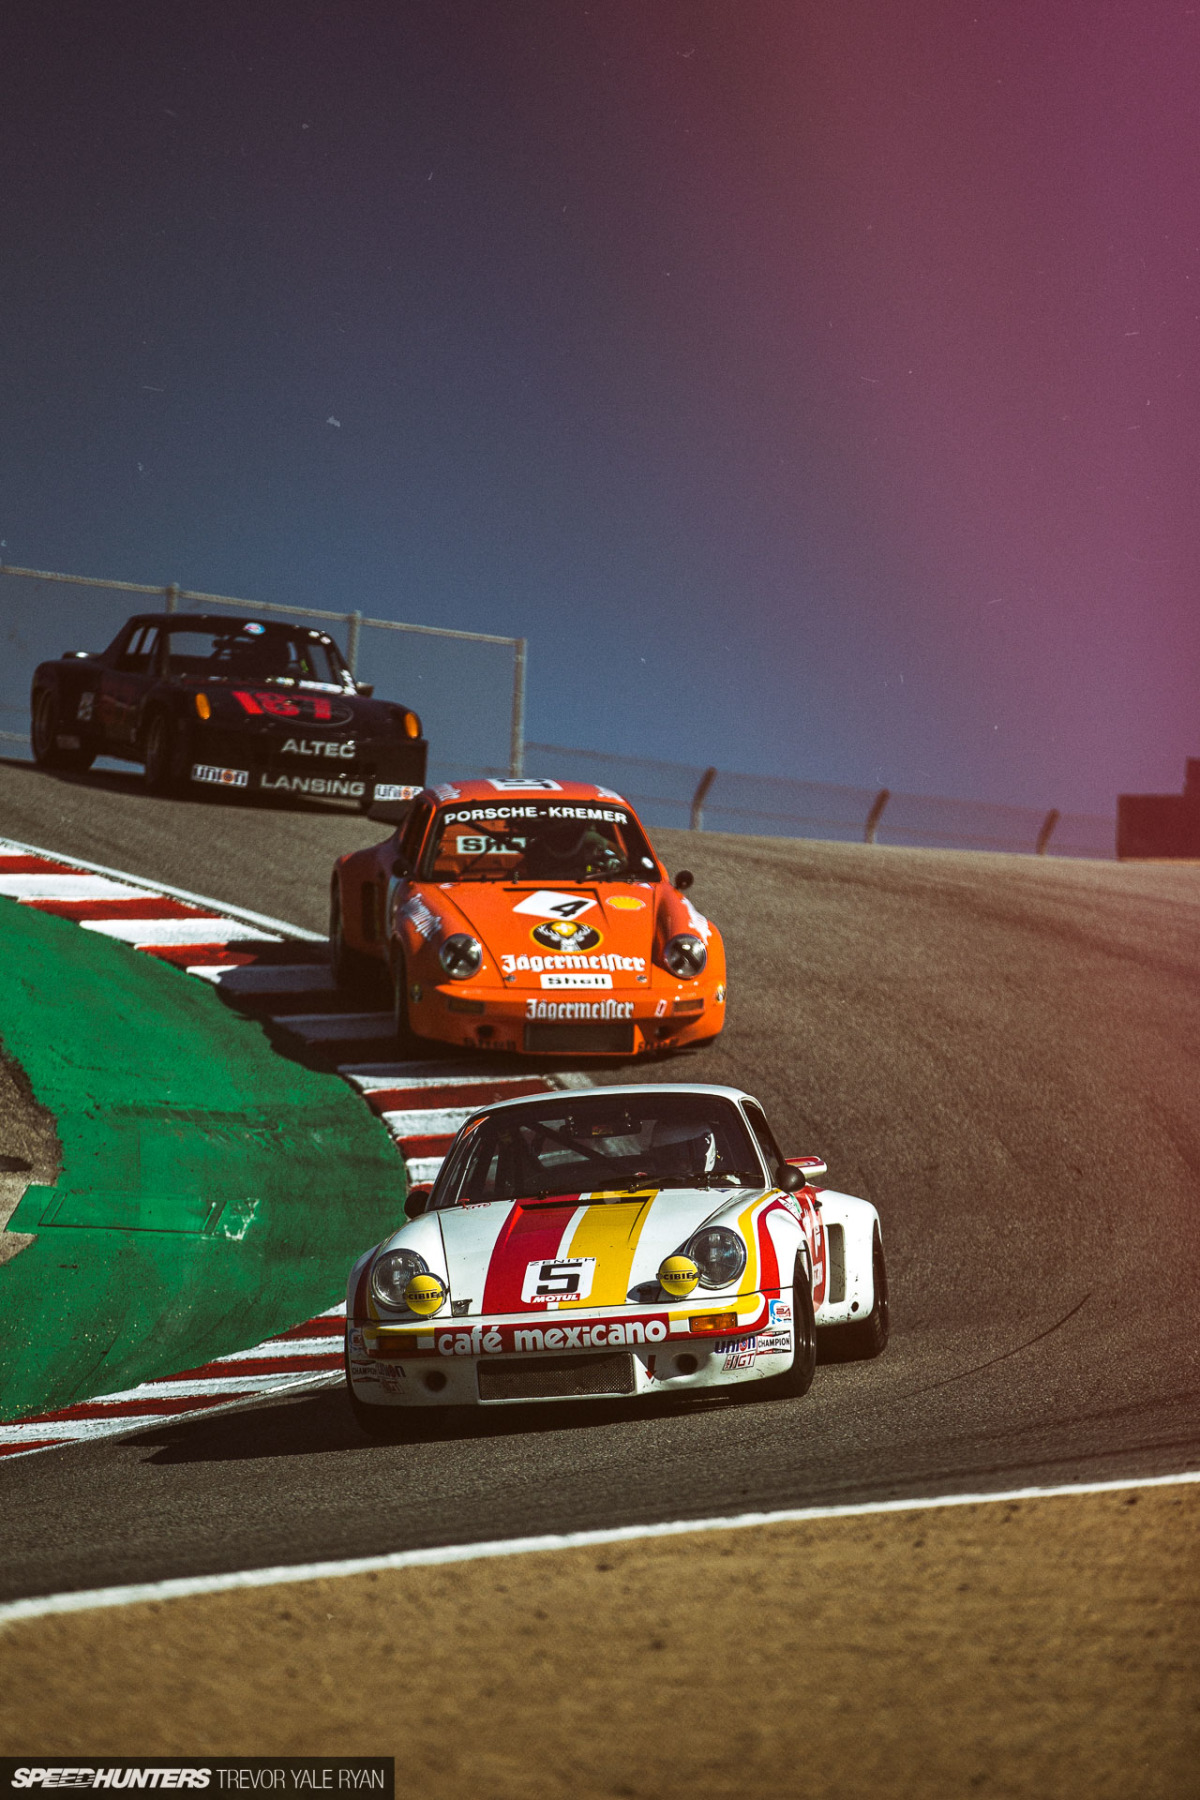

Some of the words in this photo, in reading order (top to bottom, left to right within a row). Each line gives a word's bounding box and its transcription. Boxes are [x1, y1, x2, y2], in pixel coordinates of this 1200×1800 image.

[281, 738, 356, 758] ALTEC
[260, 773, 365, 796] LANSING
[443, 806, 628, 825] PORSCHE-KREMER
[549, 900, 590, 918] 4
[547, 976, 606, 985] Shell
[529, 1257, 596, 1267] ZENITH
[536, 1262, 583, 1296] 5
[532, 1294, 579, 1303] MOTUL
[438, 1325, 503, 1356] café
[514, 1319, 667, 1352] mexicano
[757, 1337, 791, 1348] CHAMPION
[737, 1353, 755, 1368] GT
